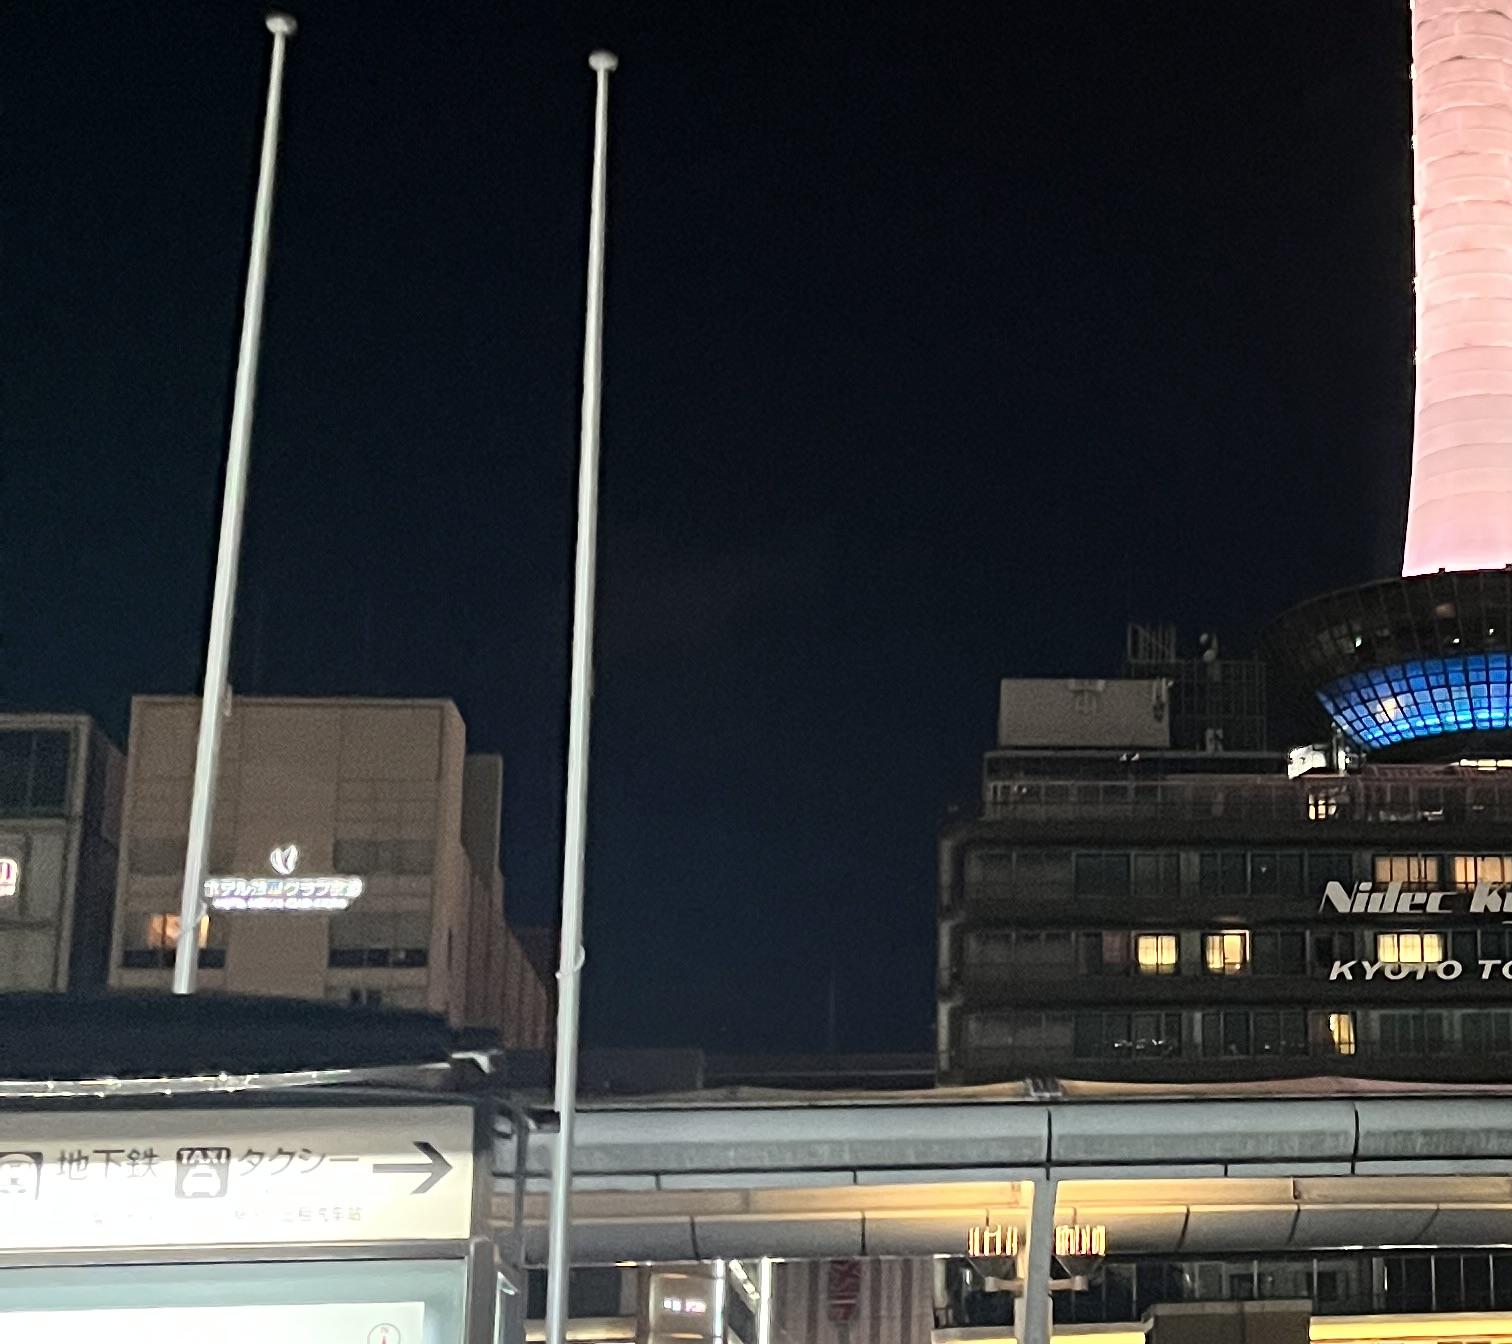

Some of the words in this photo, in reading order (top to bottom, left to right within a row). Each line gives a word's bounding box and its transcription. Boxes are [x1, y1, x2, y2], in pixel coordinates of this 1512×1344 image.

[1319, 881, 1457, 913] Nidec
[1329, 960, 1462, 980] KYOTO
[57, 1147, 160, 1180] 地下鉄
[238, 1148, 359, 1176] タクシー
